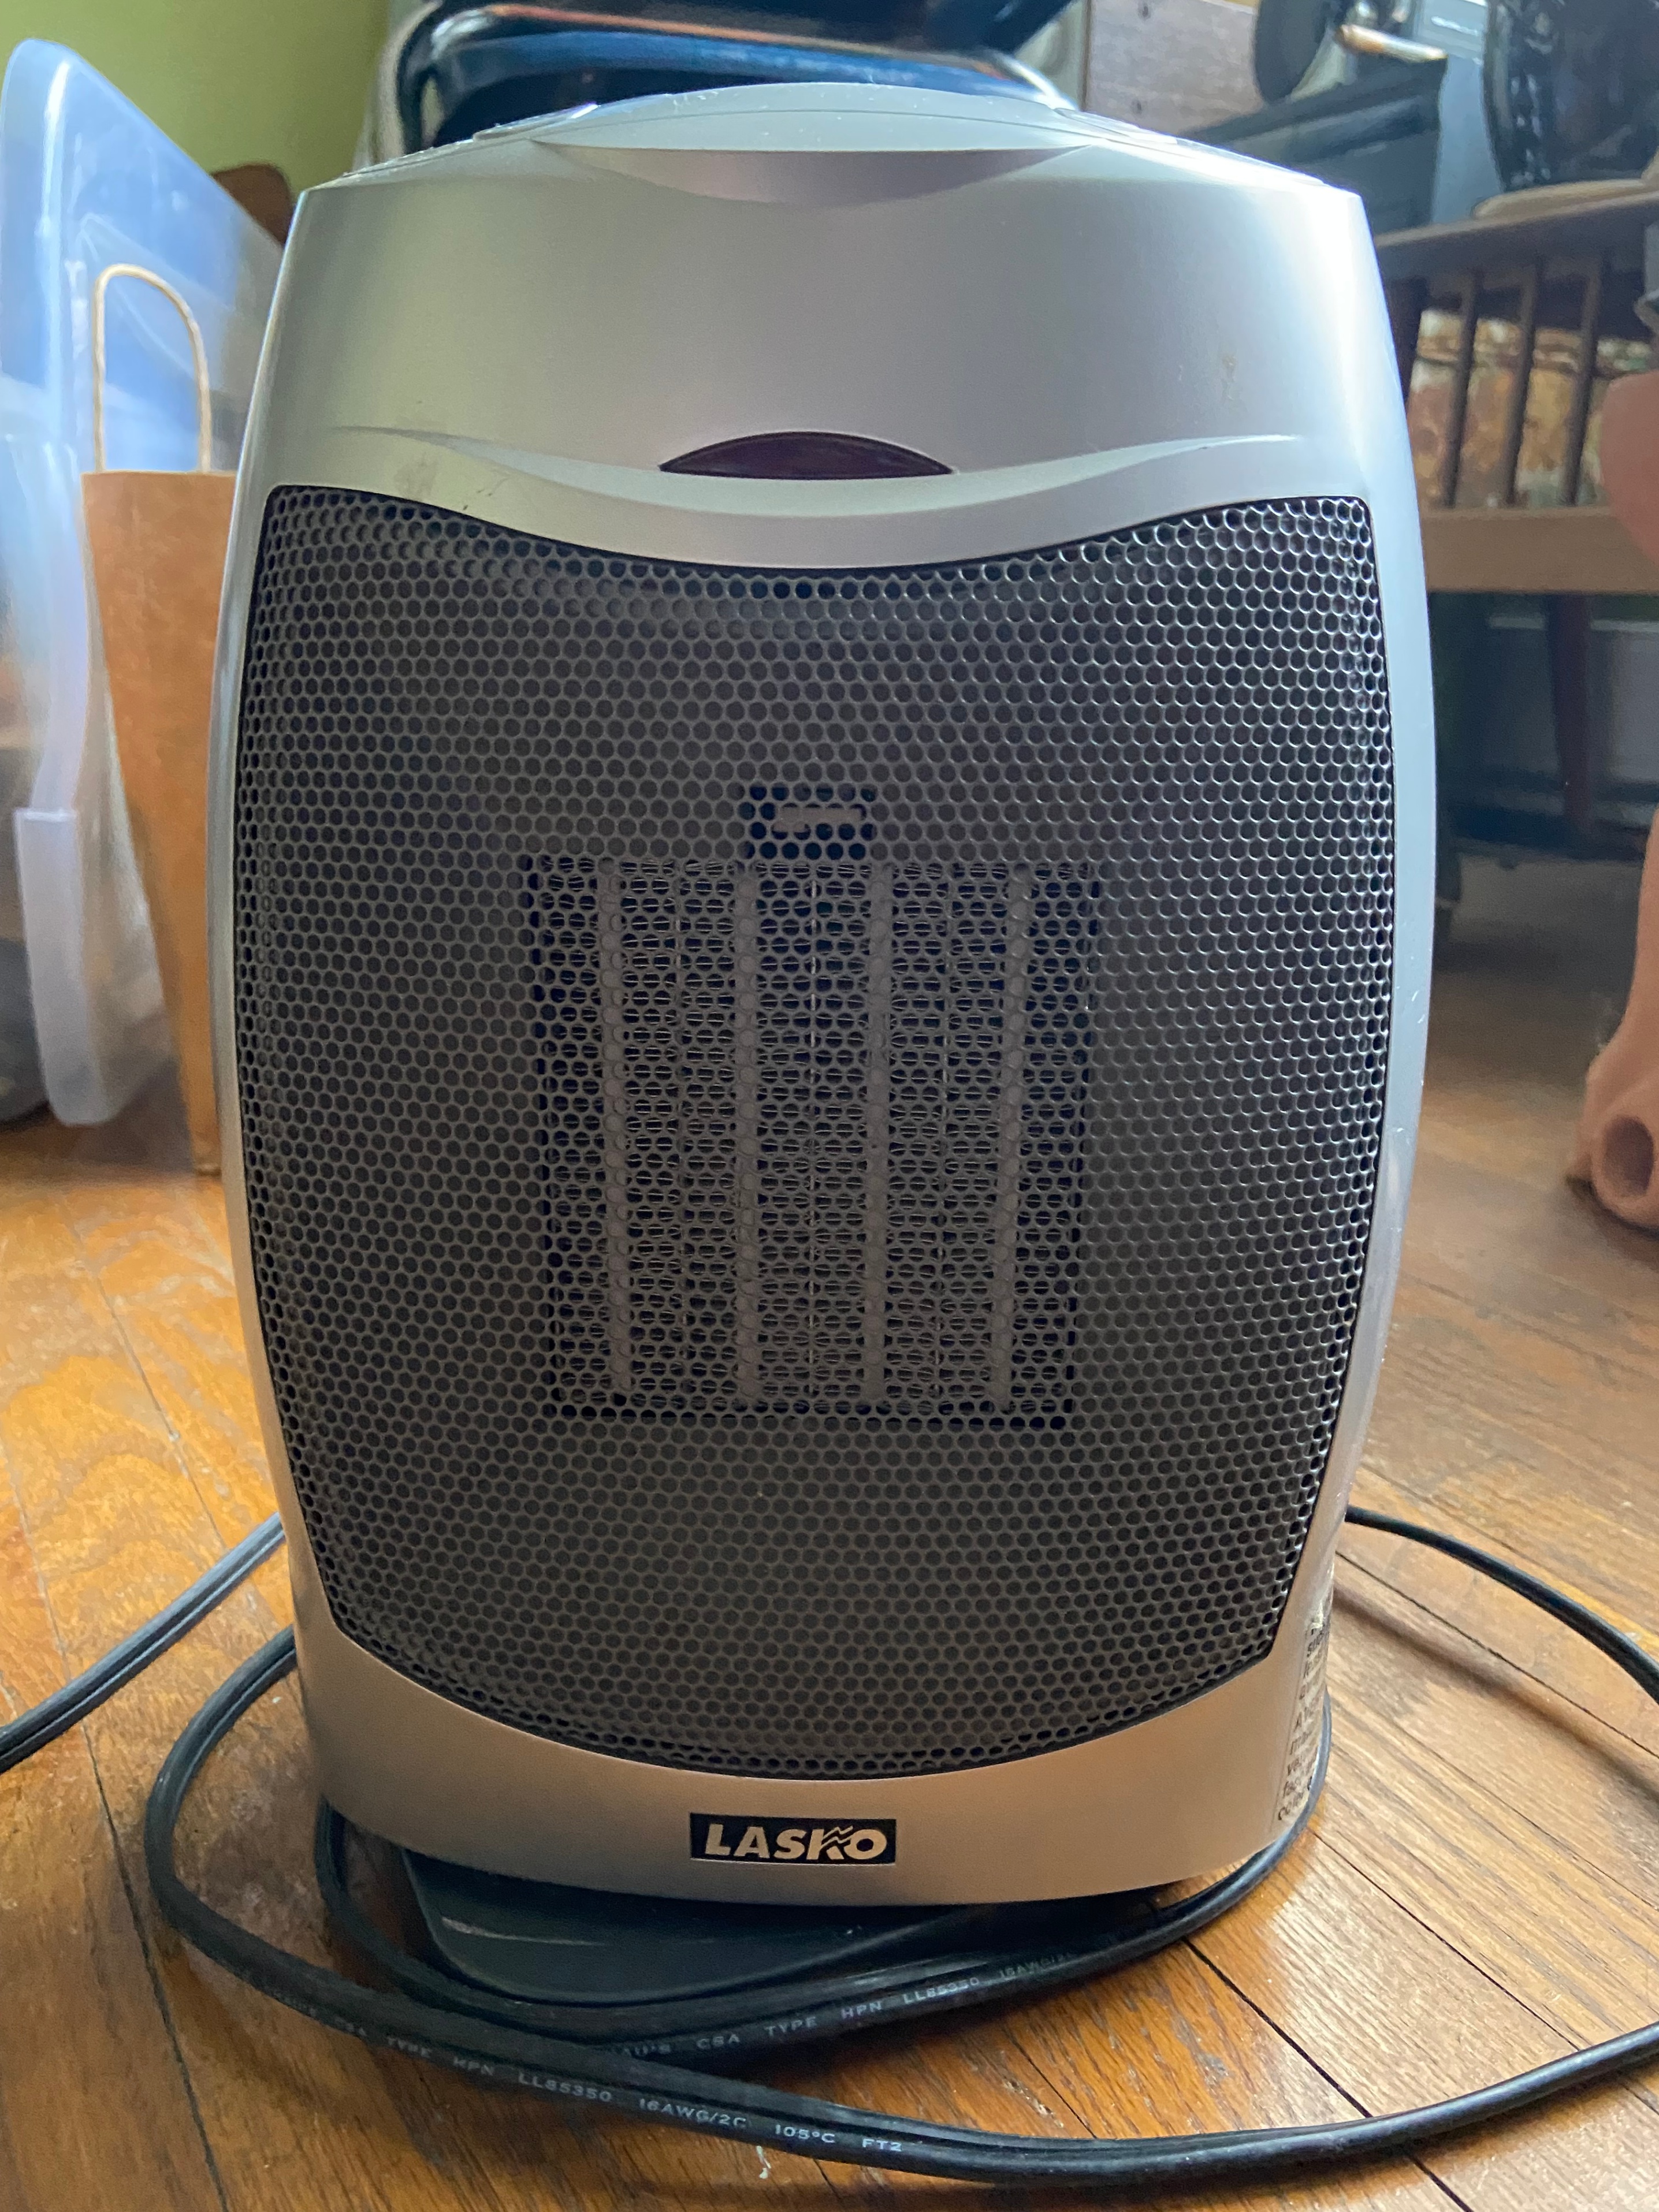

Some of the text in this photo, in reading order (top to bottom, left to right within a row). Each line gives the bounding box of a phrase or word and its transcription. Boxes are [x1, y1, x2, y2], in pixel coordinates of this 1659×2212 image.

[705, 1823, 887, 1860] LASKO
[696, 2033, 741, 2050] CSA
[765, 2016, 818, 2037] TYPE
[840, 2001, 883, 2019] HPN
[639, 2098, 747, 2128] 16AWG/2C
[862, 2138, 902, 2153] FT2
